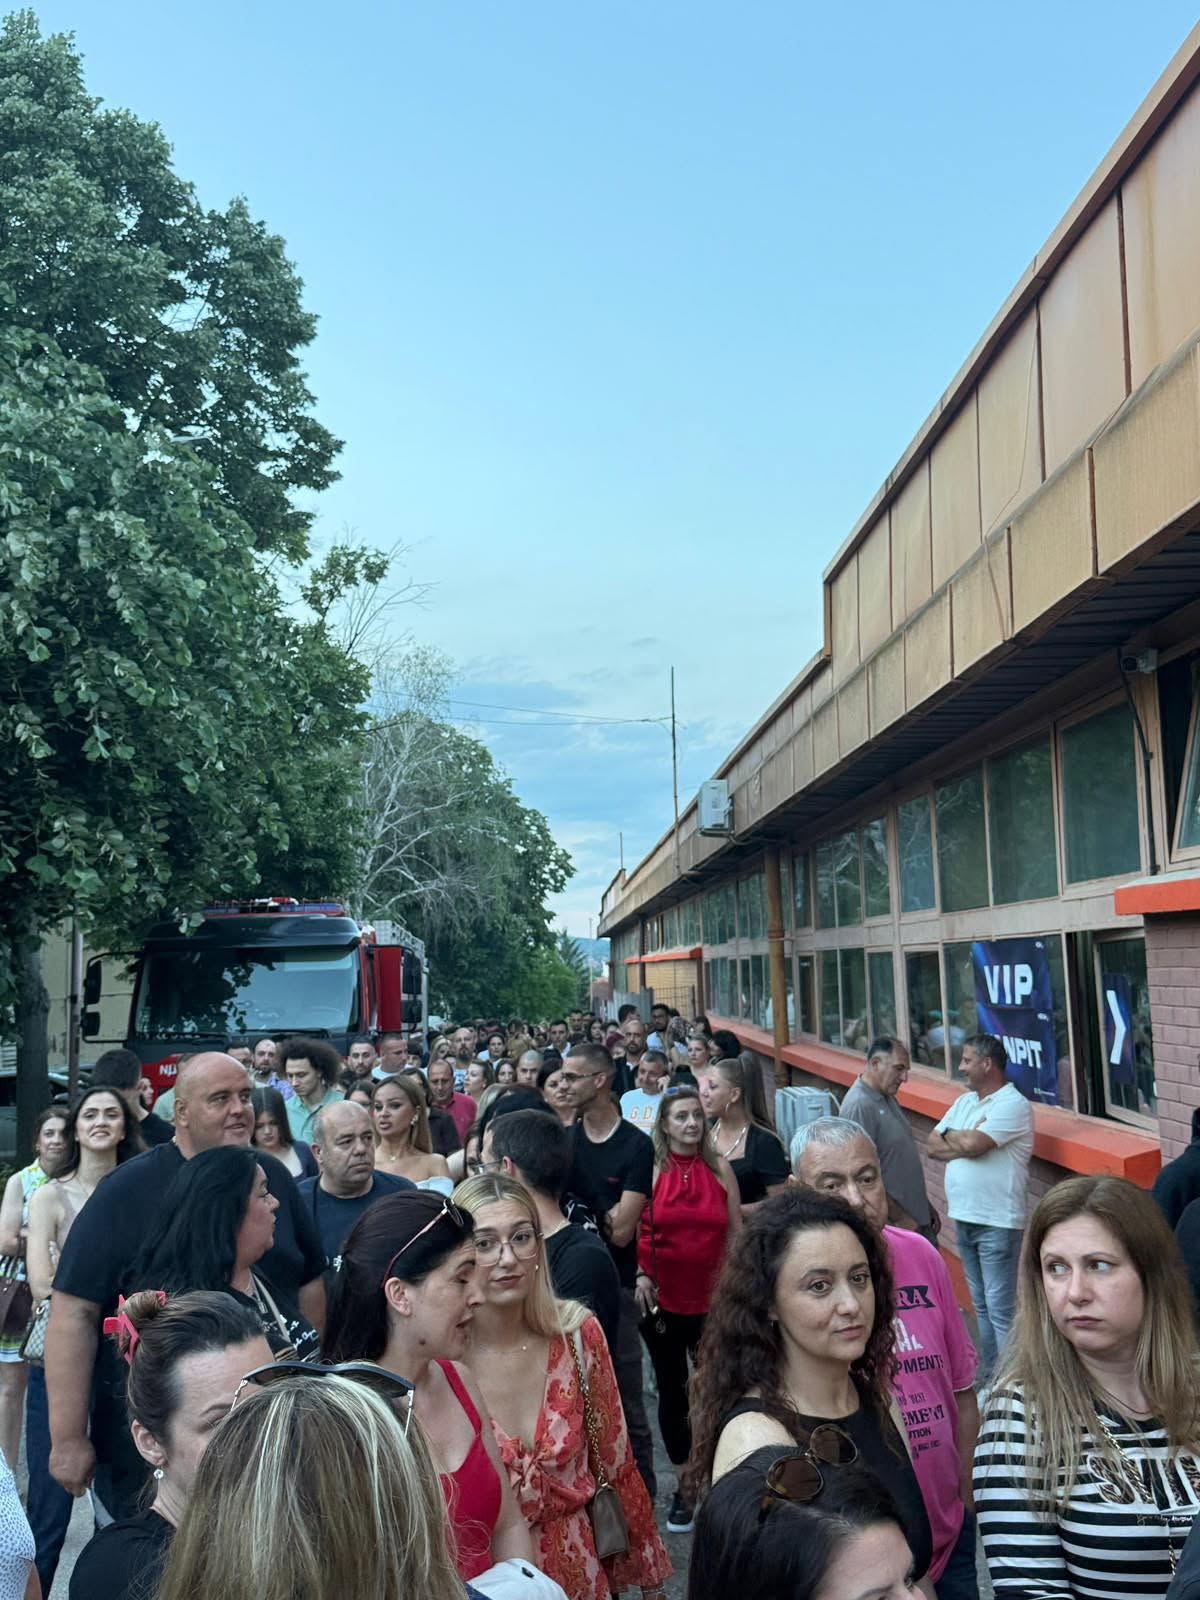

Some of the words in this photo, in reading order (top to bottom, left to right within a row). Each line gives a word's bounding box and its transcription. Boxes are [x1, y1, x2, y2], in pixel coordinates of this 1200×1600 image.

[983, 963, 1034, 1005] VIP
[996, 1033, 1042, 1069] NPIT
[896, 1287, 928, 1308] RA
[895, 1354, 944, 1376] PMENT
